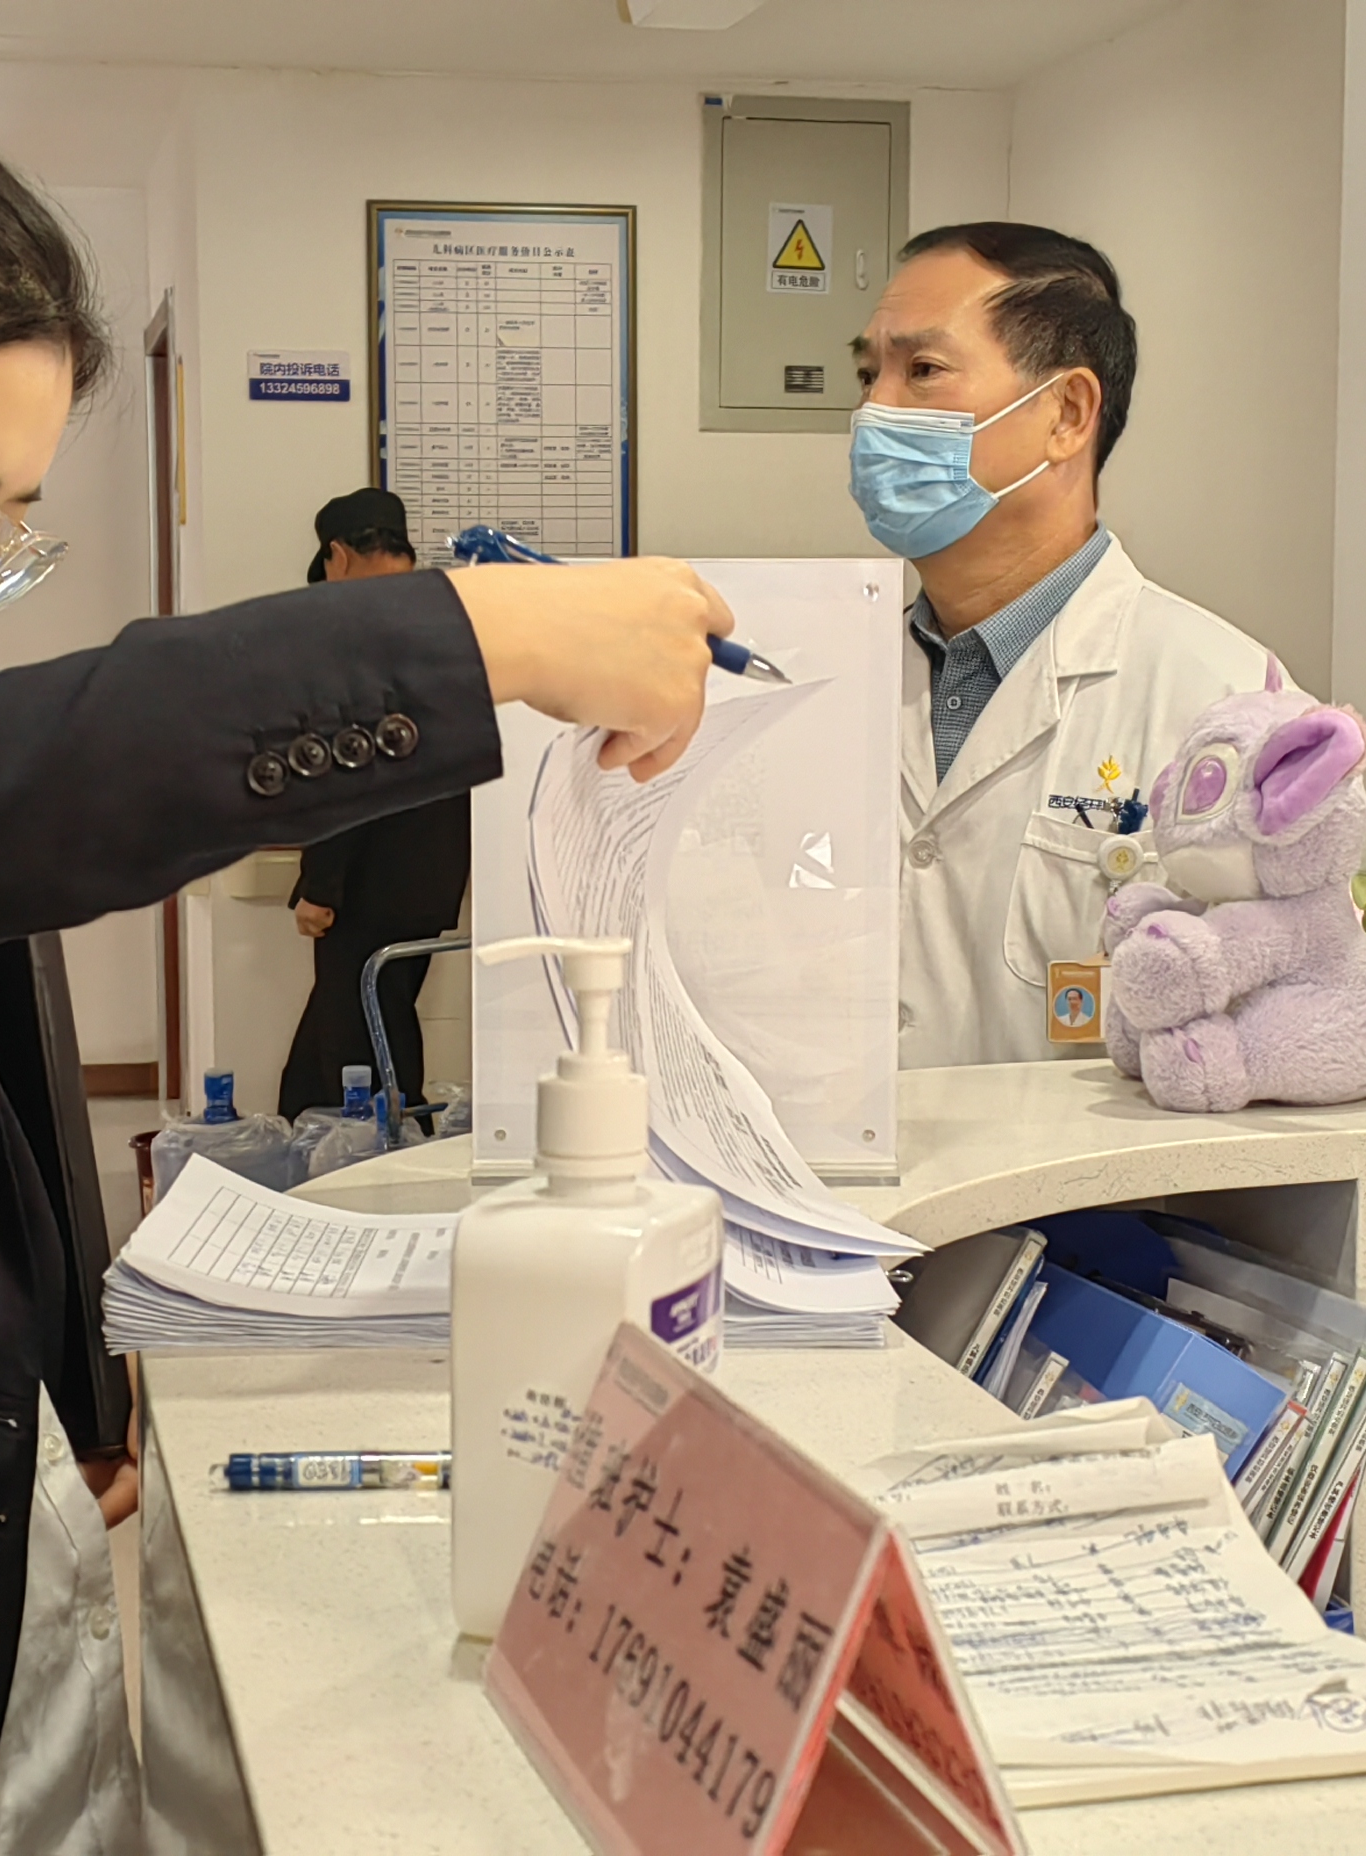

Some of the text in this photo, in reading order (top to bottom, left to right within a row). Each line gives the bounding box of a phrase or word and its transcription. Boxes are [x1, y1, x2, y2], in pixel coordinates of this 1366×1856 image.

[777, 274, 820, 288] 有电危险
[259, 362, 340, 377] 院内投诉电话
[259, 382, 340, 395] 13324596898
